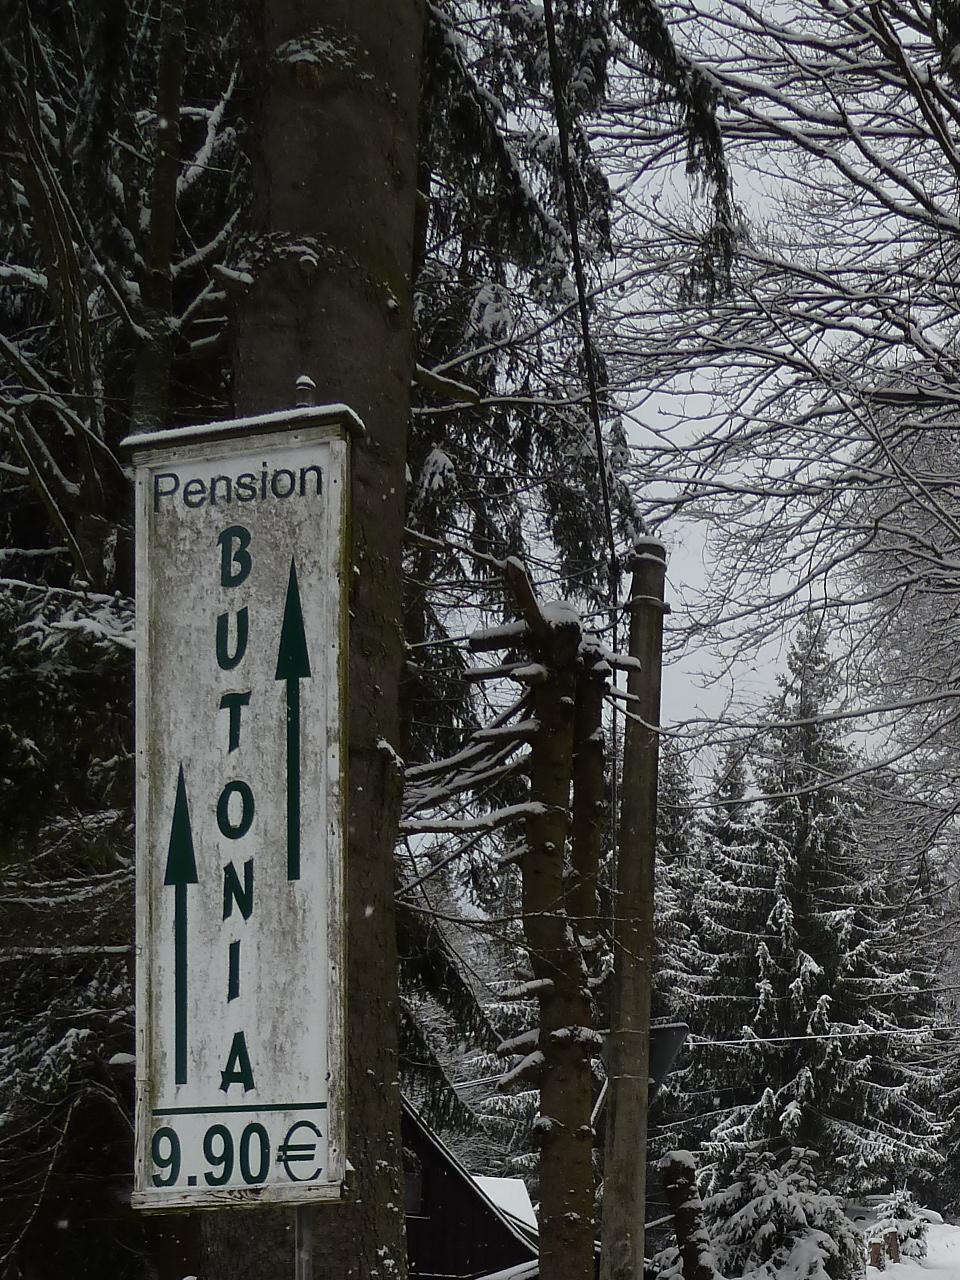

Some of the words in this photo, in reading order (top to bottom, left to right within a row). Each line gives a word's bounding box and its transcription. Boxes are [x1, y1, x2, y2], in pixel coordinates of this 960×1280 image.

[154, 461, 323, 513] Pension
[216, 524, 256, 1093] BUTONIA
[151, 1120, 323, 1187] 9.90€
